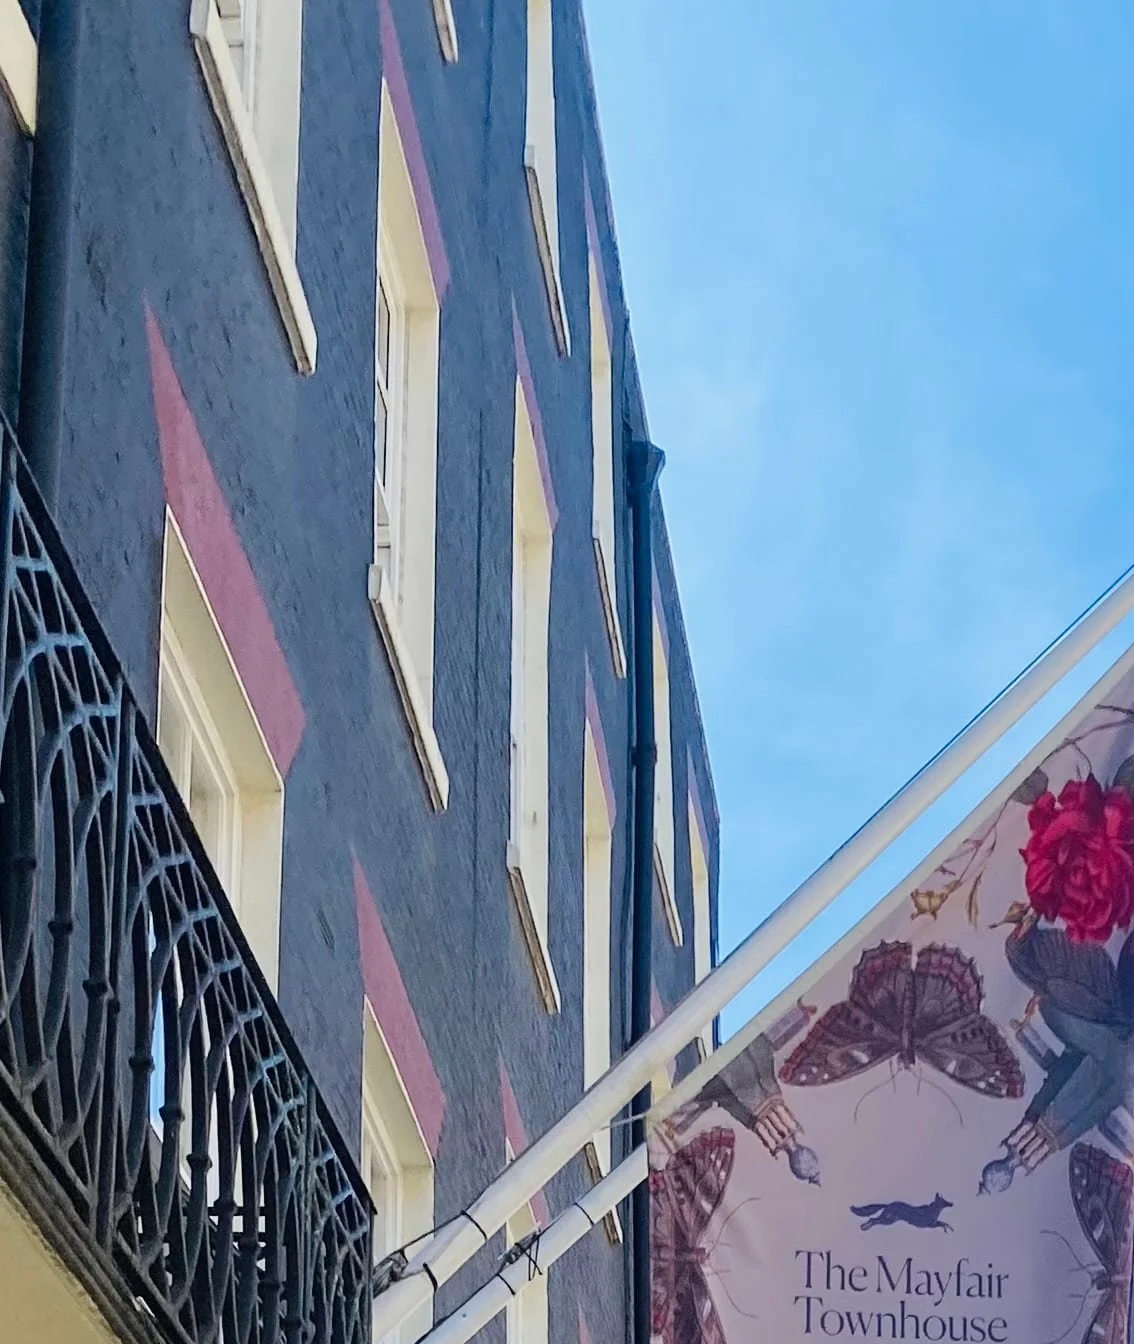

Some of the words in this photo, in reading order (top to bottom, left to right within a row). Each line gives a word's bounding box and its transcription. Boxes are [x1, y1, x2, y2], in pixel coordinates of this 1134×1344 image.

[795, 1249, 868, 1292] The
[876, 1255, 1010, 1307] Mayfair
[793, 1295, 1009, 1343] Townhouse
